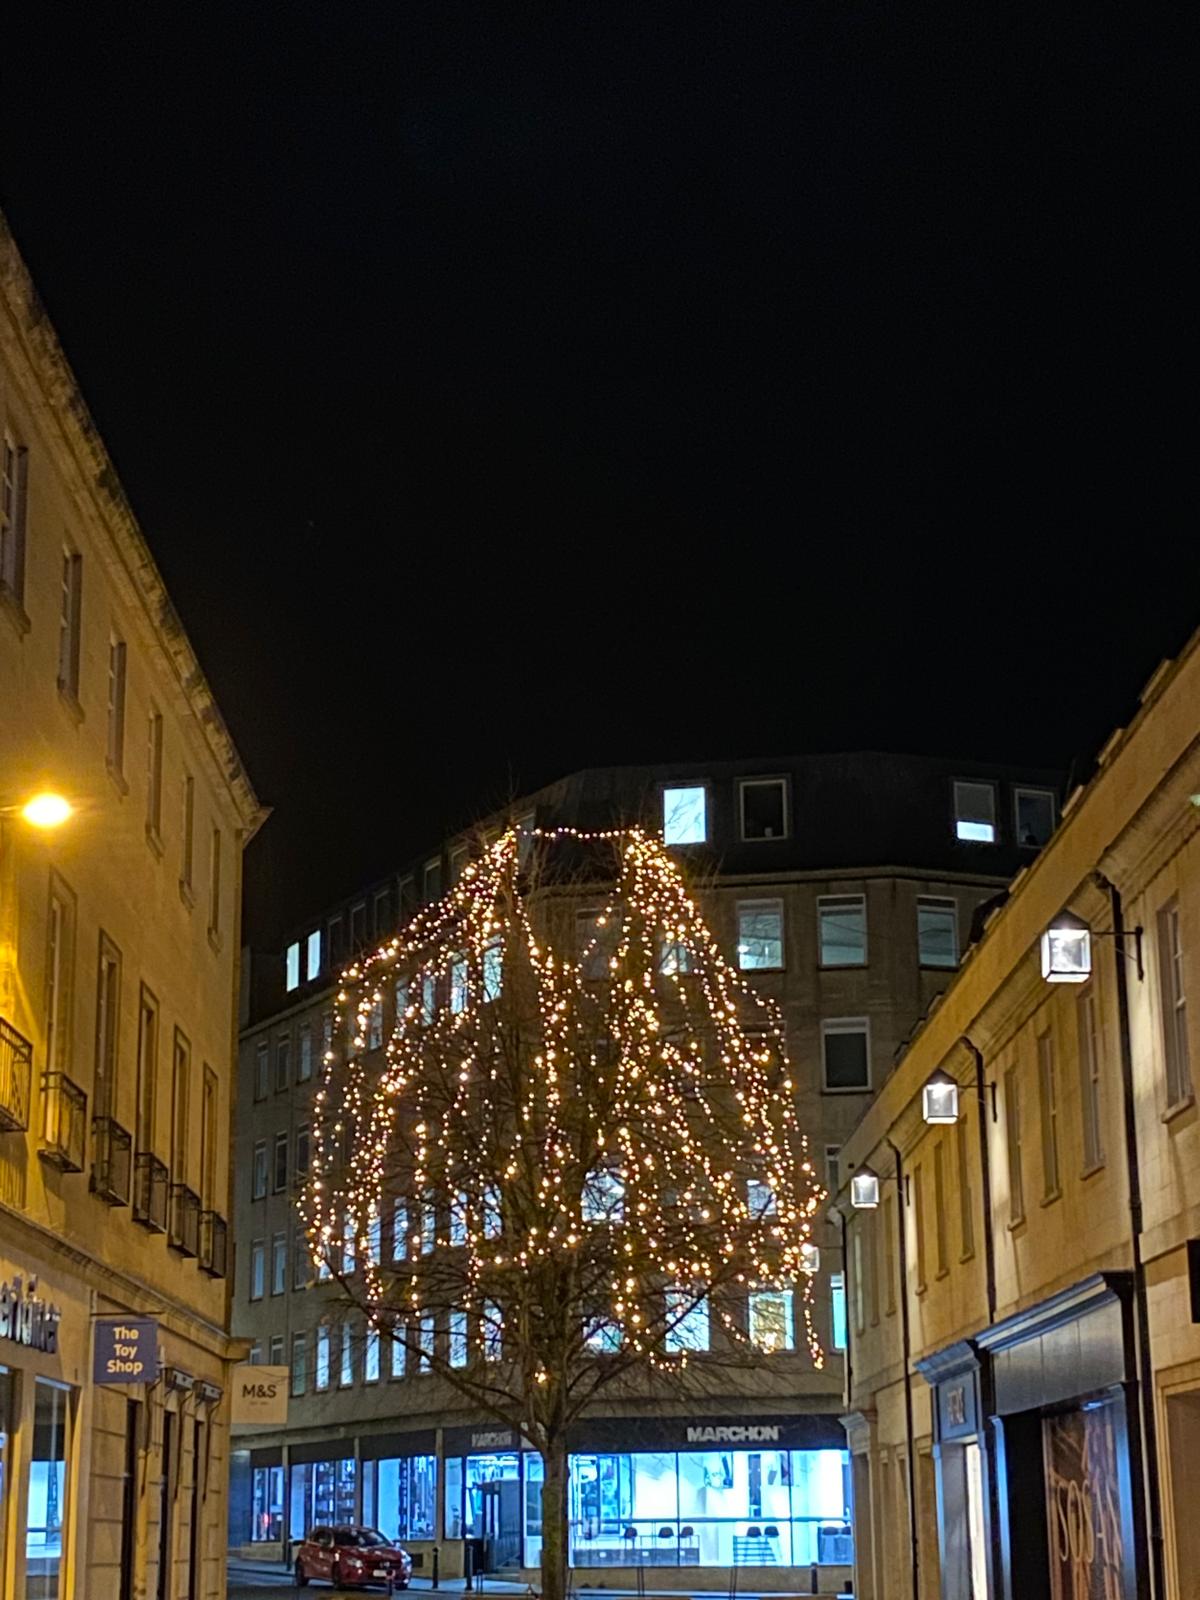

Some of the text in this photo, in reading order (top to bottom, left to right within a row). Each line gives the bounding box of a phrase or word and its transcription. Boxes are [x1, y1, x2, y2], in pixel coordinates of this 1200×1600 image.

[113, 1326, 139, 1340] The
[113, 1343, 138, 1360] Toy
[107, 1359, 144, 1375] Shop
[242, 1383, 277, 1399] M&S
[687, 1425, 779, 1442] MARCHON
